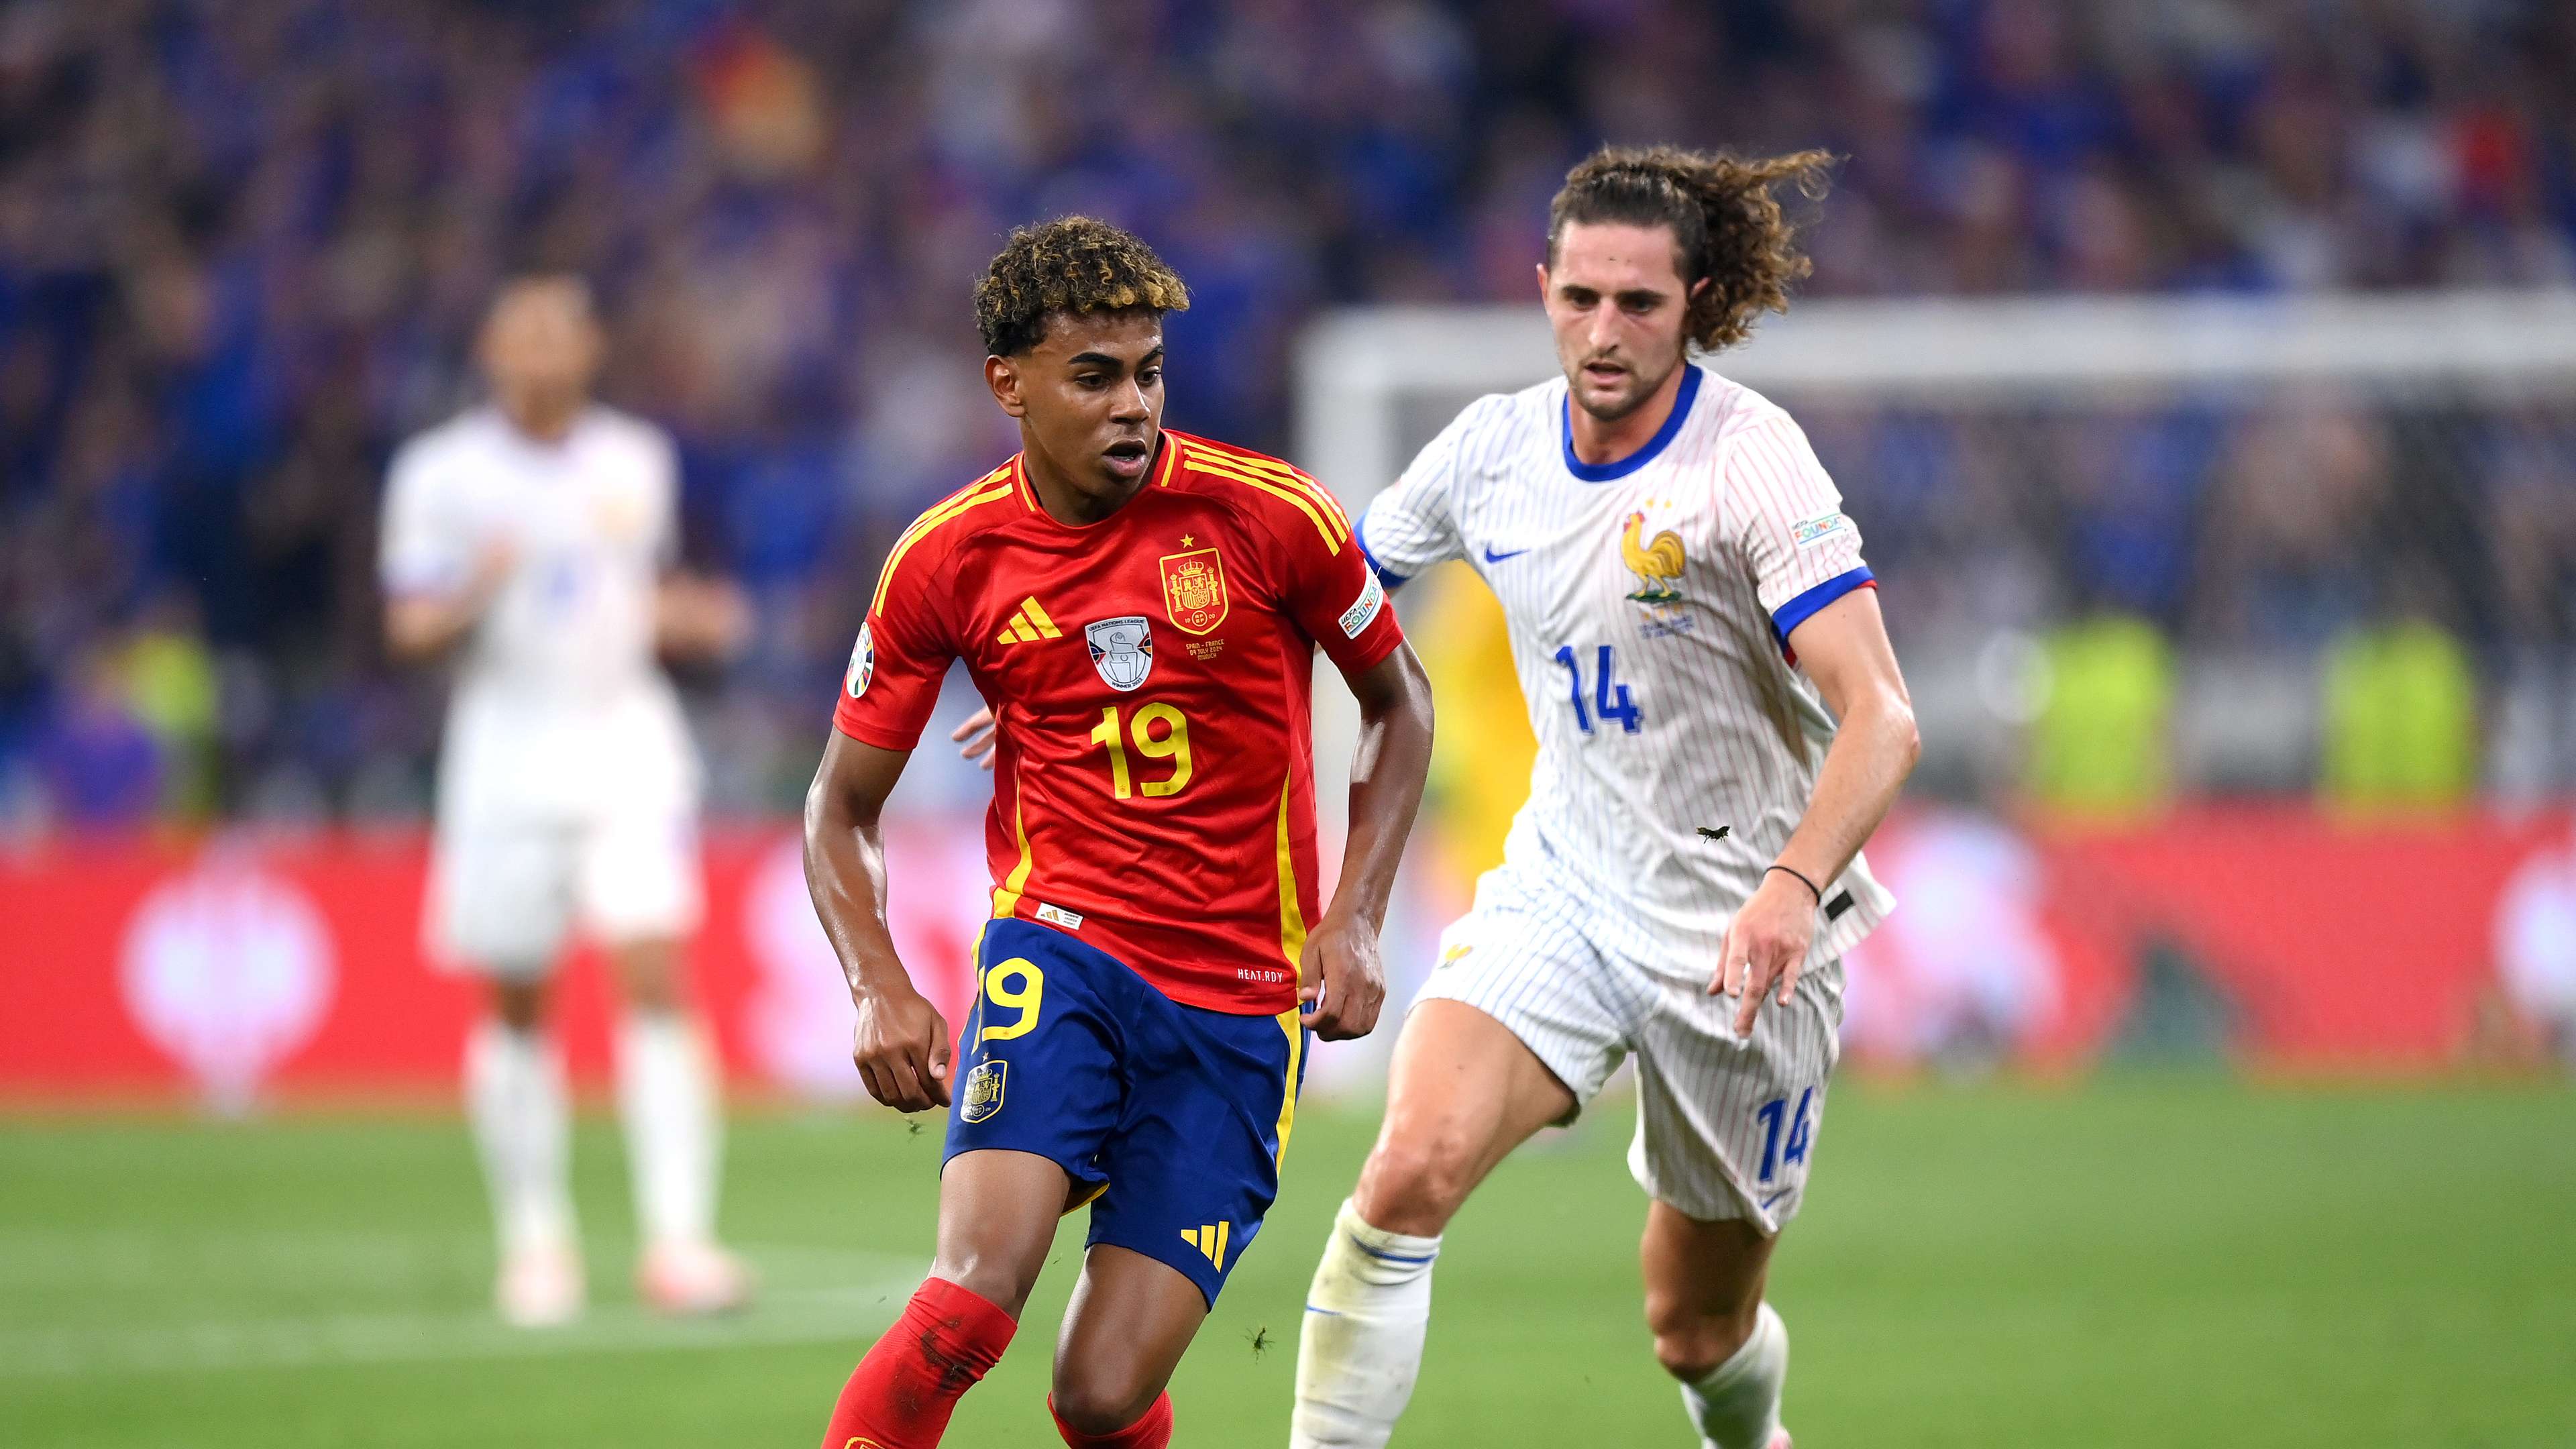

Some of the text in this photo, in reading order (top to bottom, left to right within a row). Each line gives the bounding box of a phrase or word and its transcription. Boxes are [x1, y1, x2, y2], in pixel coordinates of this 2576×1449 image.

[1341, 608, 1358, 625] UEFA
[1205, 639, 1224, 647] FRANCE
[1112, 681, 1132, 689] WINNER
[1556, 645, 1644, 733] 14
[1091, 702, 1193, 800] 19
[1237, 968, 1283, 983] HEAT.RDY
[1757, 1085, 1813, 1182] 14
